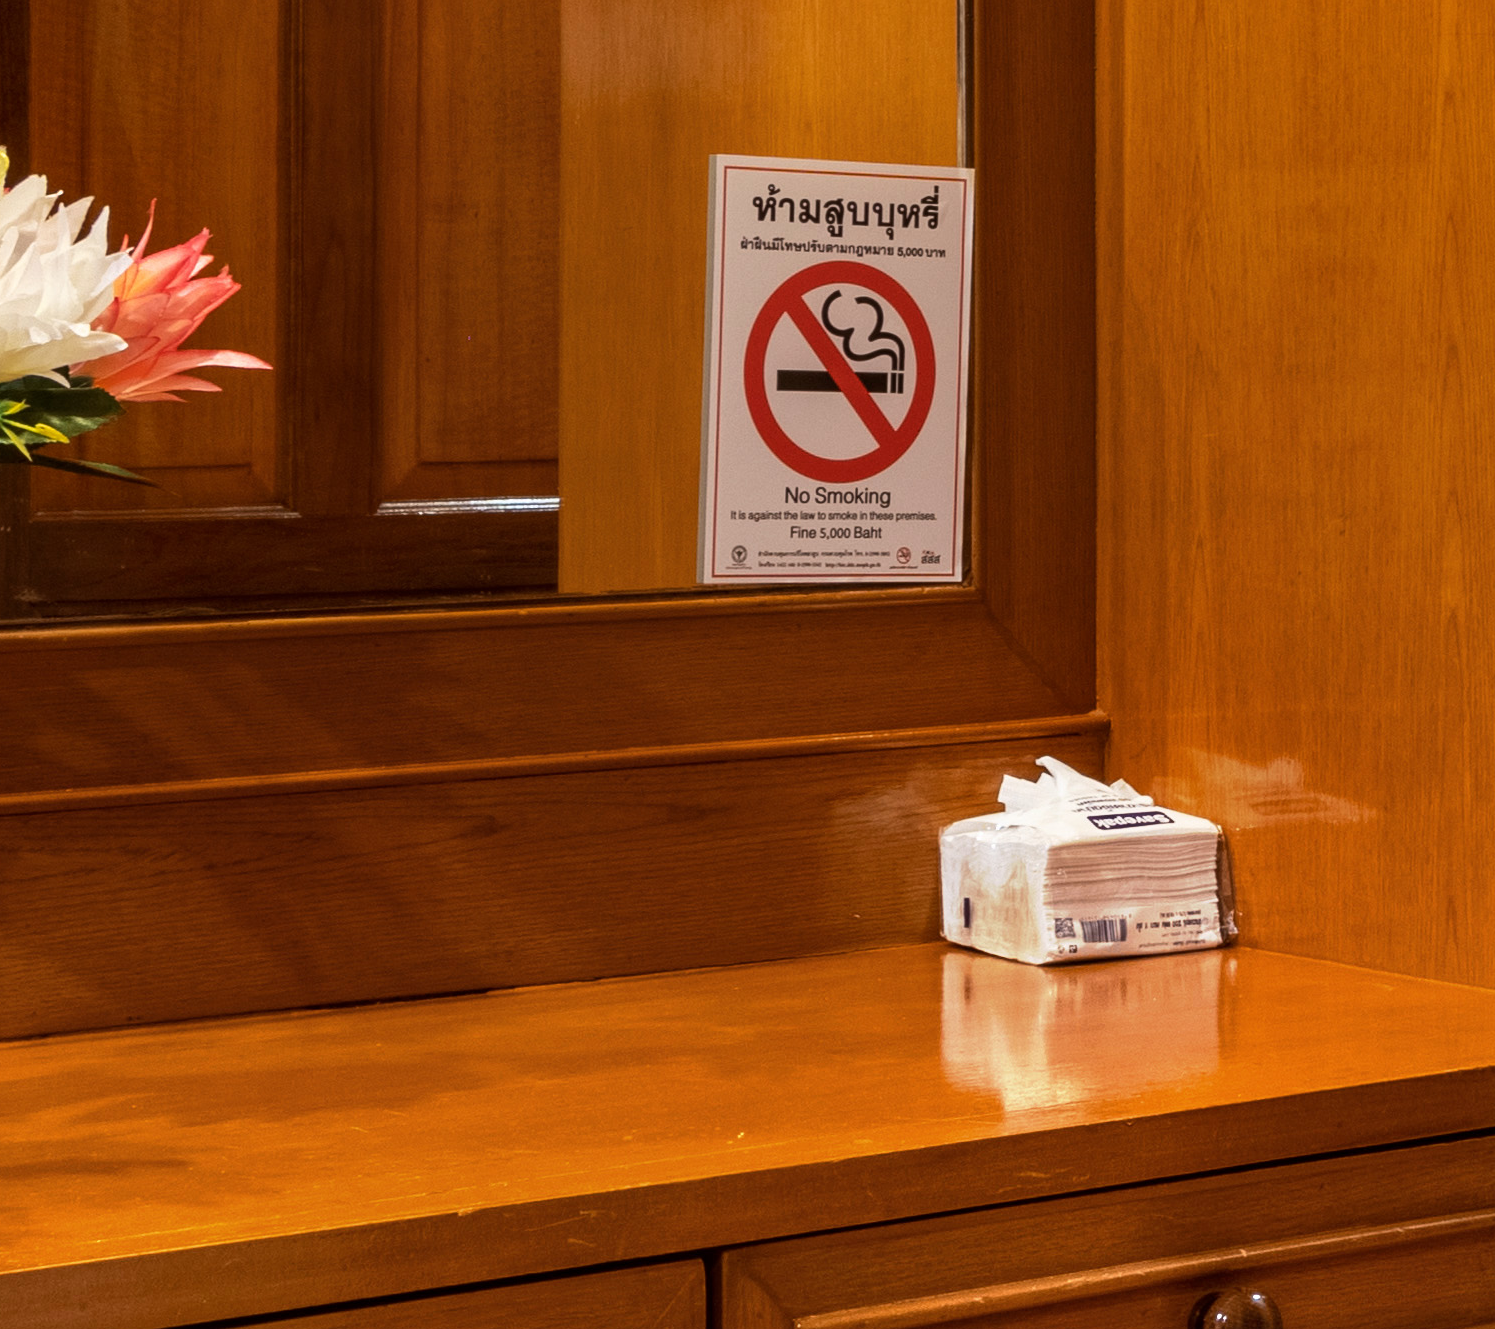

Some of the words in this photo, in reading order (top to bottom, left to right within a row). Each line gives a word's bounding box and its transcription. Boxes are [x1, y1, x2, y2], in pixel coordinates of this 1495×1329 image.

[752, 184, 940, 240] ห้ามสูบบุหรี่
[897, 247, 923, 259] 5,000
[925, 247, 946, 258] บาท
[785, 487, 810, 504] No
[815, 487, 891, 509] Smoking
[731, 511, 737, 520] It
[738, 511, 746, 520] is
[748, 511, 782, 522] against
[784, 511, 798, 520] the
[800, 511, 816, 520] law
[817, 512, 826, 520] to
[828, 511, 858, 521] smoke
[859, 512, 867, 520] in
[869, 512, 894, 521] these
[895, 512, 937, 523] premises.
[790, 526, 816, 539] Fine
[819, 528, 851, 540] 5,000
[854, 526, 882, 539] Baht
[1093, 814, 1170, 828] Savepak
